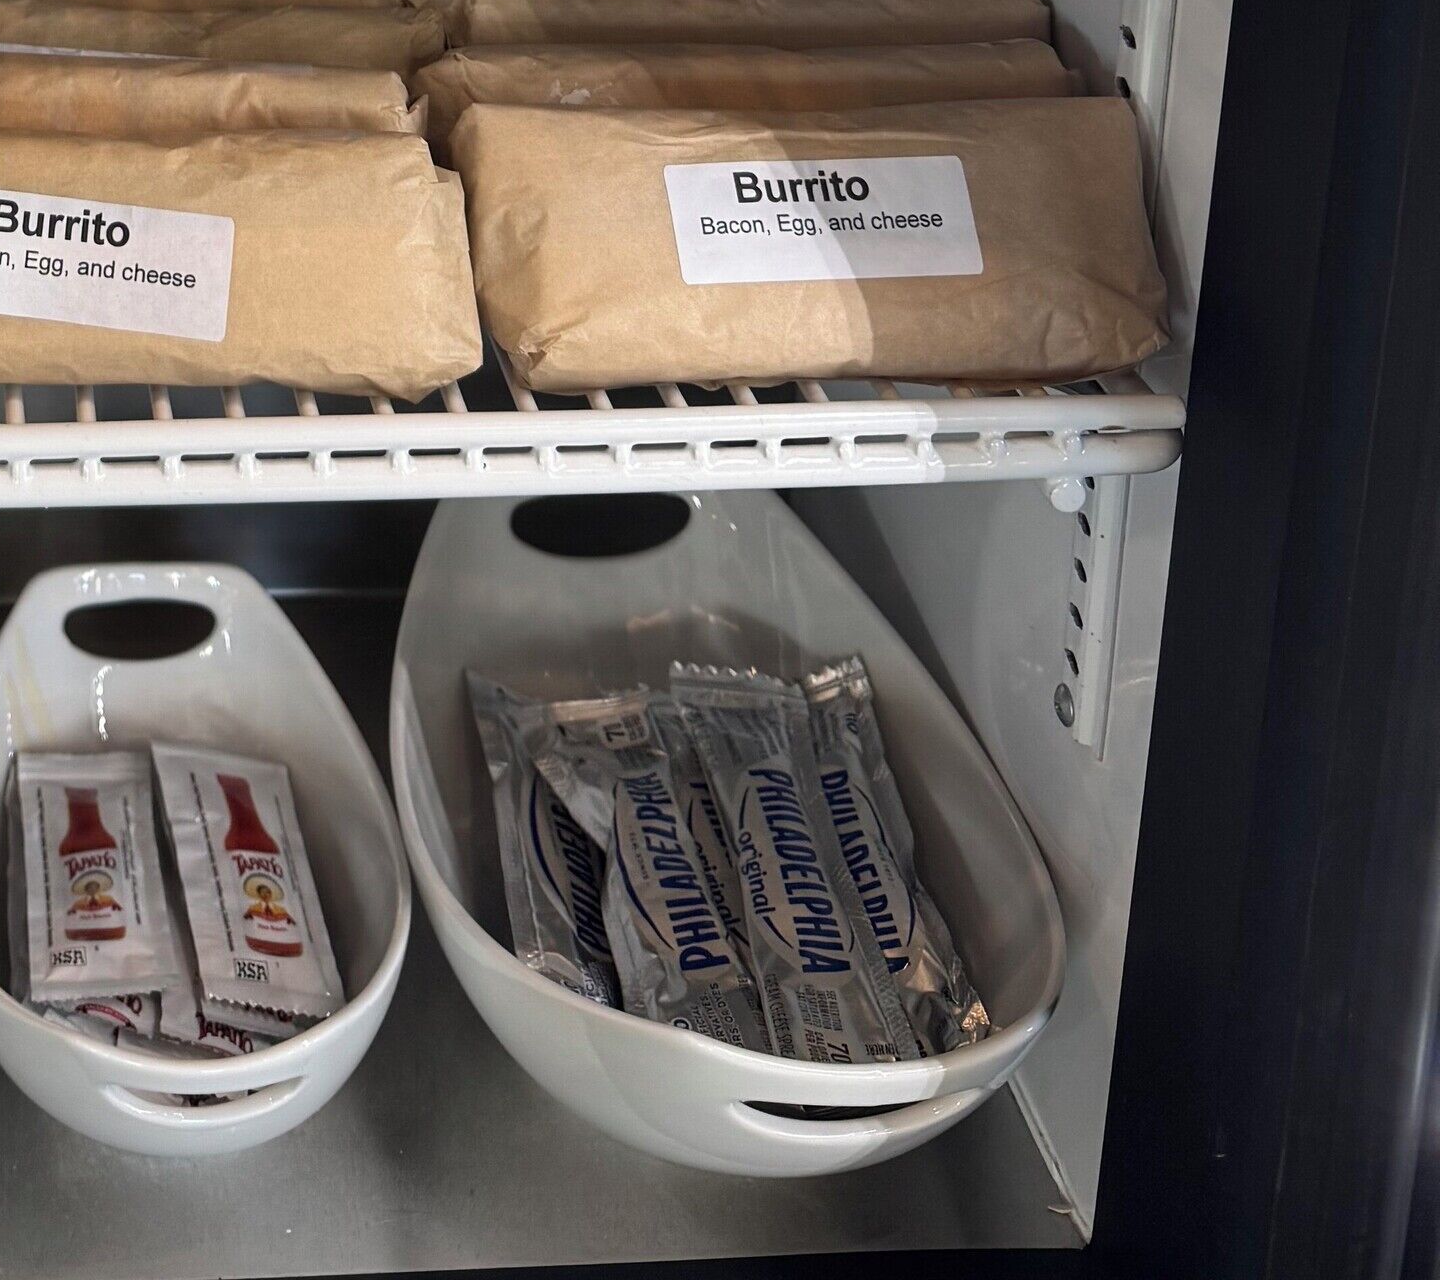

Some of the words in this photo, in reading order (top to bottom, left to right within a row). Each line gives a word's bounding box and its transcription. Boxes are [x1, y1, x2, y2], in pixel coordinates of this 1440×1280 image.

[733, 171, 870, 204] Burrito
[701, 216, 771, 236] Bacon,
[778, 214, 823, 236] Egg,
[829, 213, 865, 231] and
[871, 211, 944, 230] cheese
[24, 250, 70, 277] Egg,
[77, 259, 115, 279] and
[122, 264, 197, 289] cheese
[624, 771, 730, 976] PHILADELPHIA
[739, 831, 776, 916] original
[749, 767, 852, 973] PHILADELPHIA
